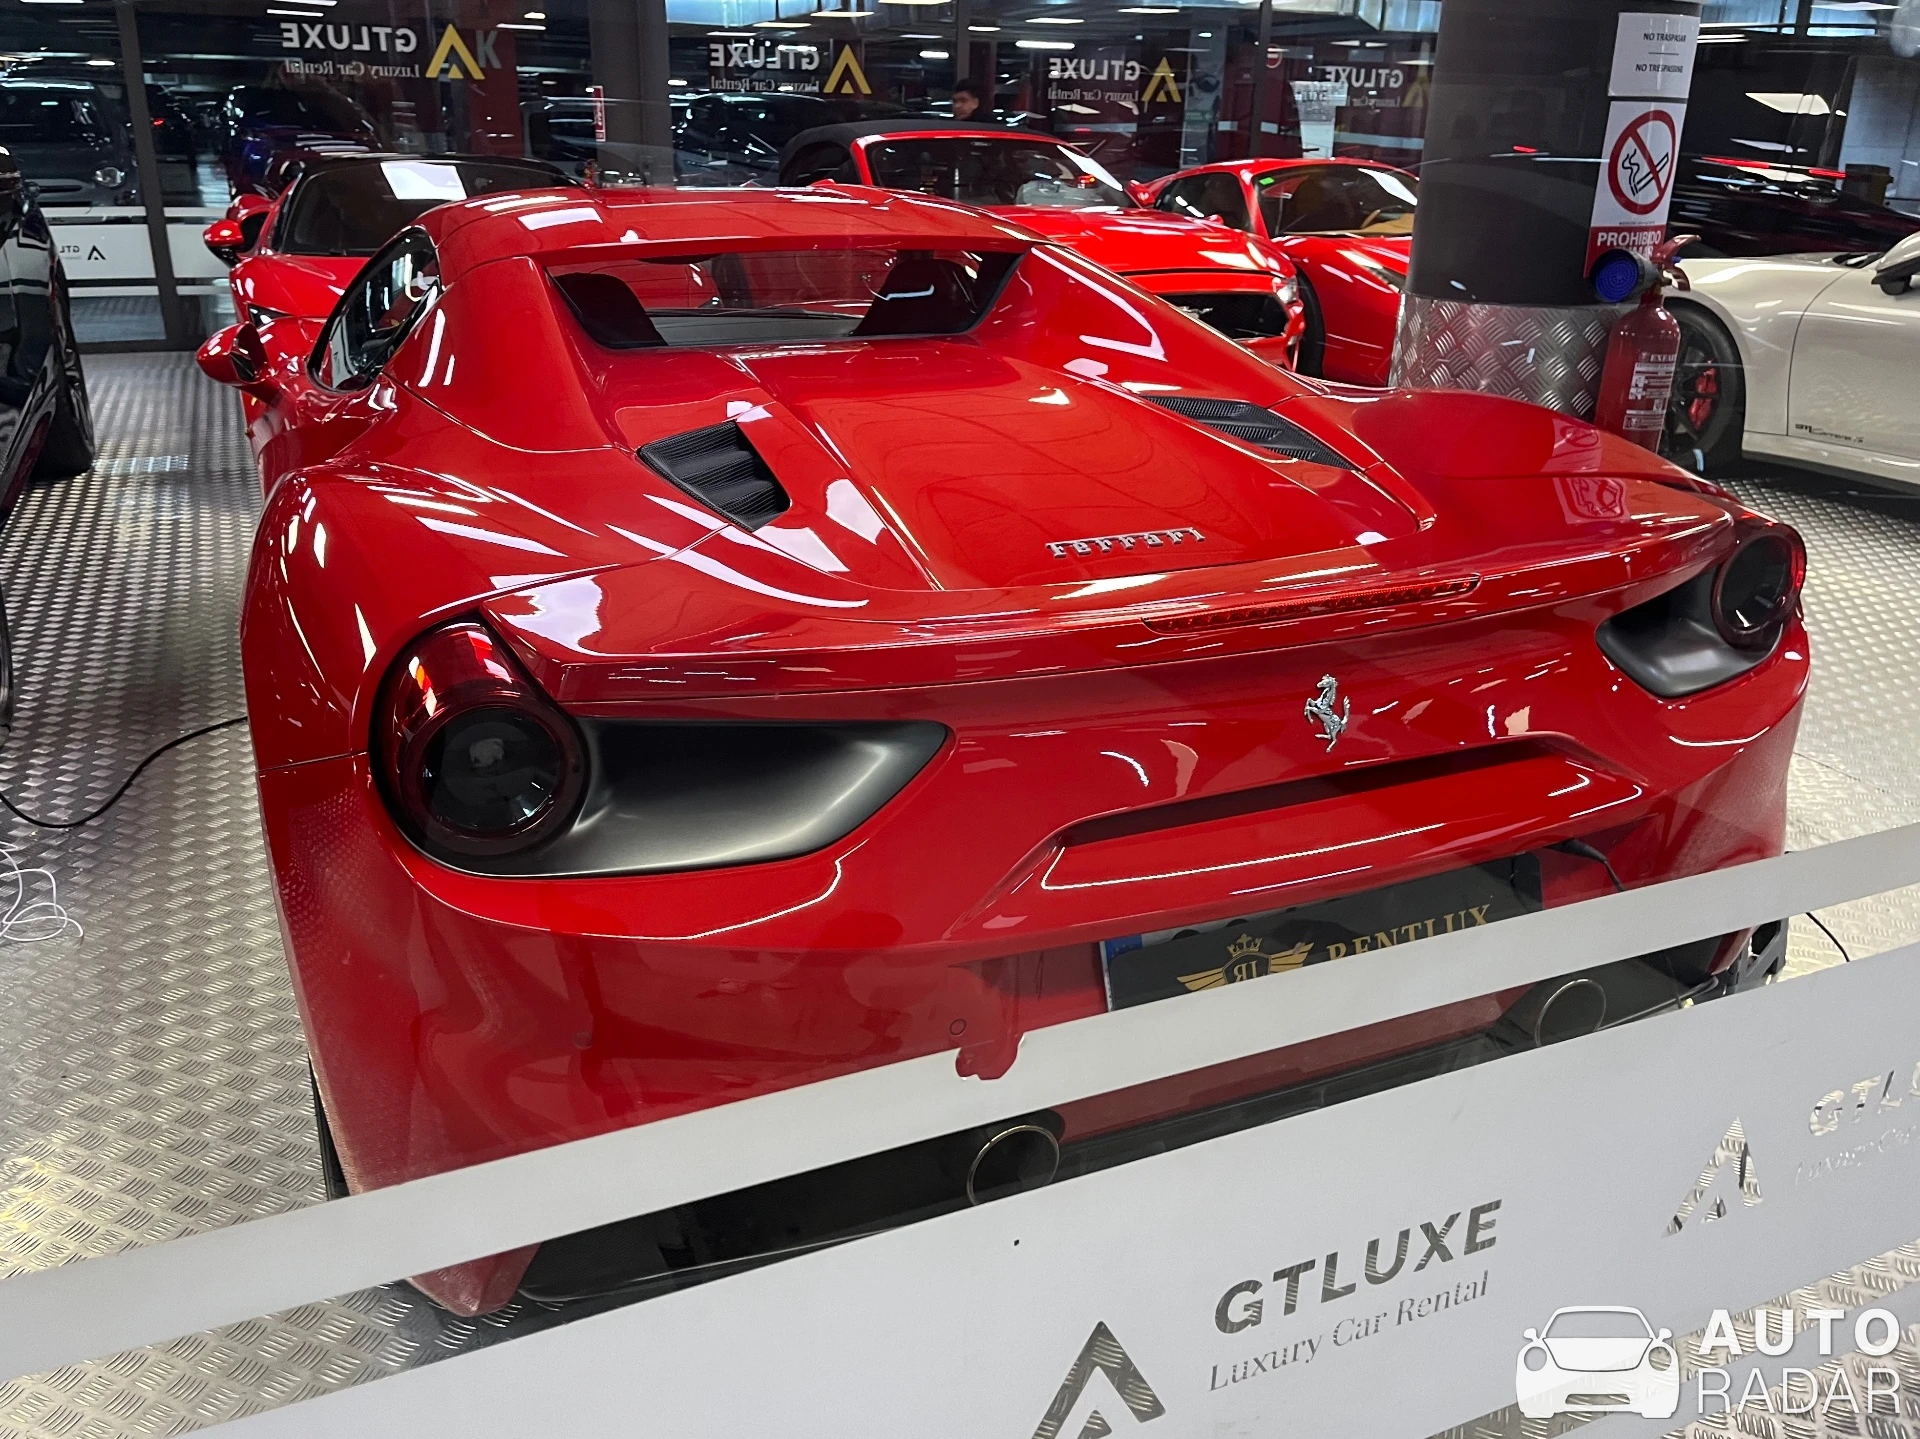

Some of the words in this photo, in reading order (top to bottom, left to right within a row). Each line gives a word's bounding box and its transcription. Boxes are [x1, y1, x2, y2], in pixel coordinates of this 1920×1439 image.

[1643, 32, 1655, 41] NO
[1635, 63, 1648, 72] NO
[1597, 230, 1662, 247] PROHIBIDO
[1046, 526, 1205, 558] Ferrari
[1215, 1198, 1502, 1335] GTLUXE
[1209, 1334, 1323, 1392] Luxury
[1332, 1311, 1388, 1347] Car
[1394, 1269, 1489, 1327] Rental
